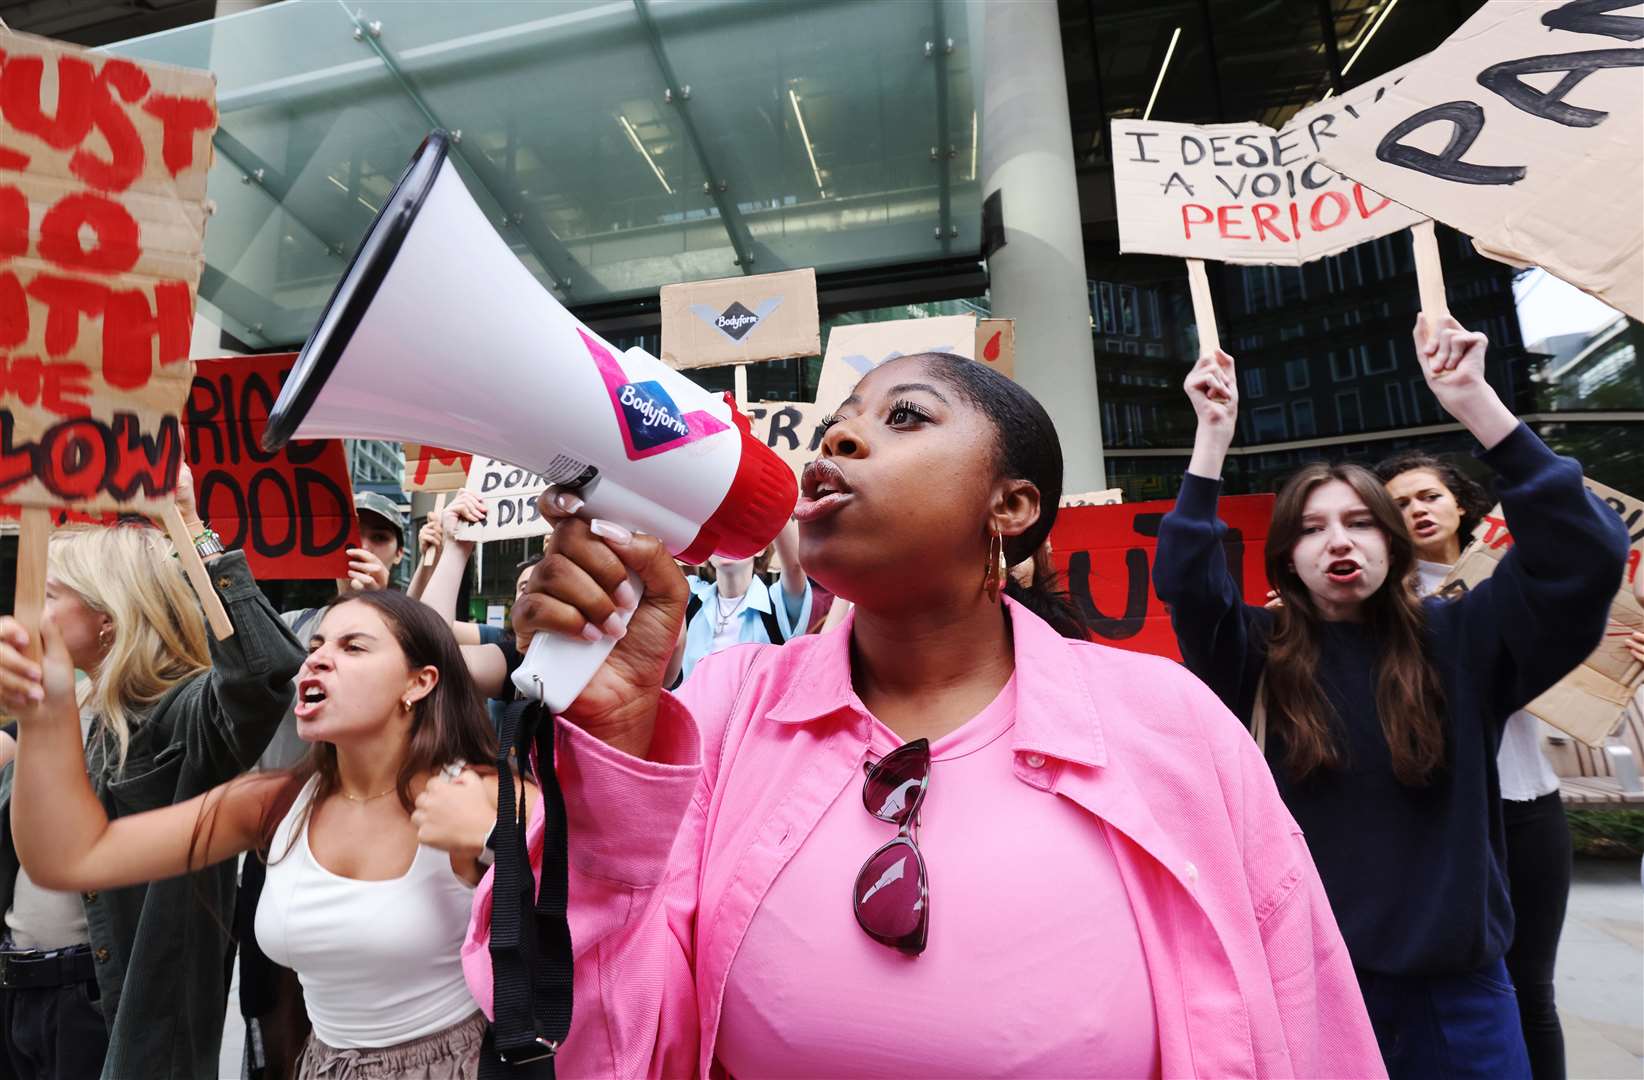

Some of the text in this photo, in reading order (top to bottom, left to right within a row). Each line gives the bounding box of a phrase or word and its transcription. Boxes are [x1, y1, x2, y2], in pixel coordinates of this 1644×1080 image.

[0, 52, 216, 193] UST
[1125, 132, 1160, 163] I
[1160, 161, 1340, 199] A VOIC
[718, 314, 757, 329] Bodyform
[620, 384, 688, 436] Bodyform
